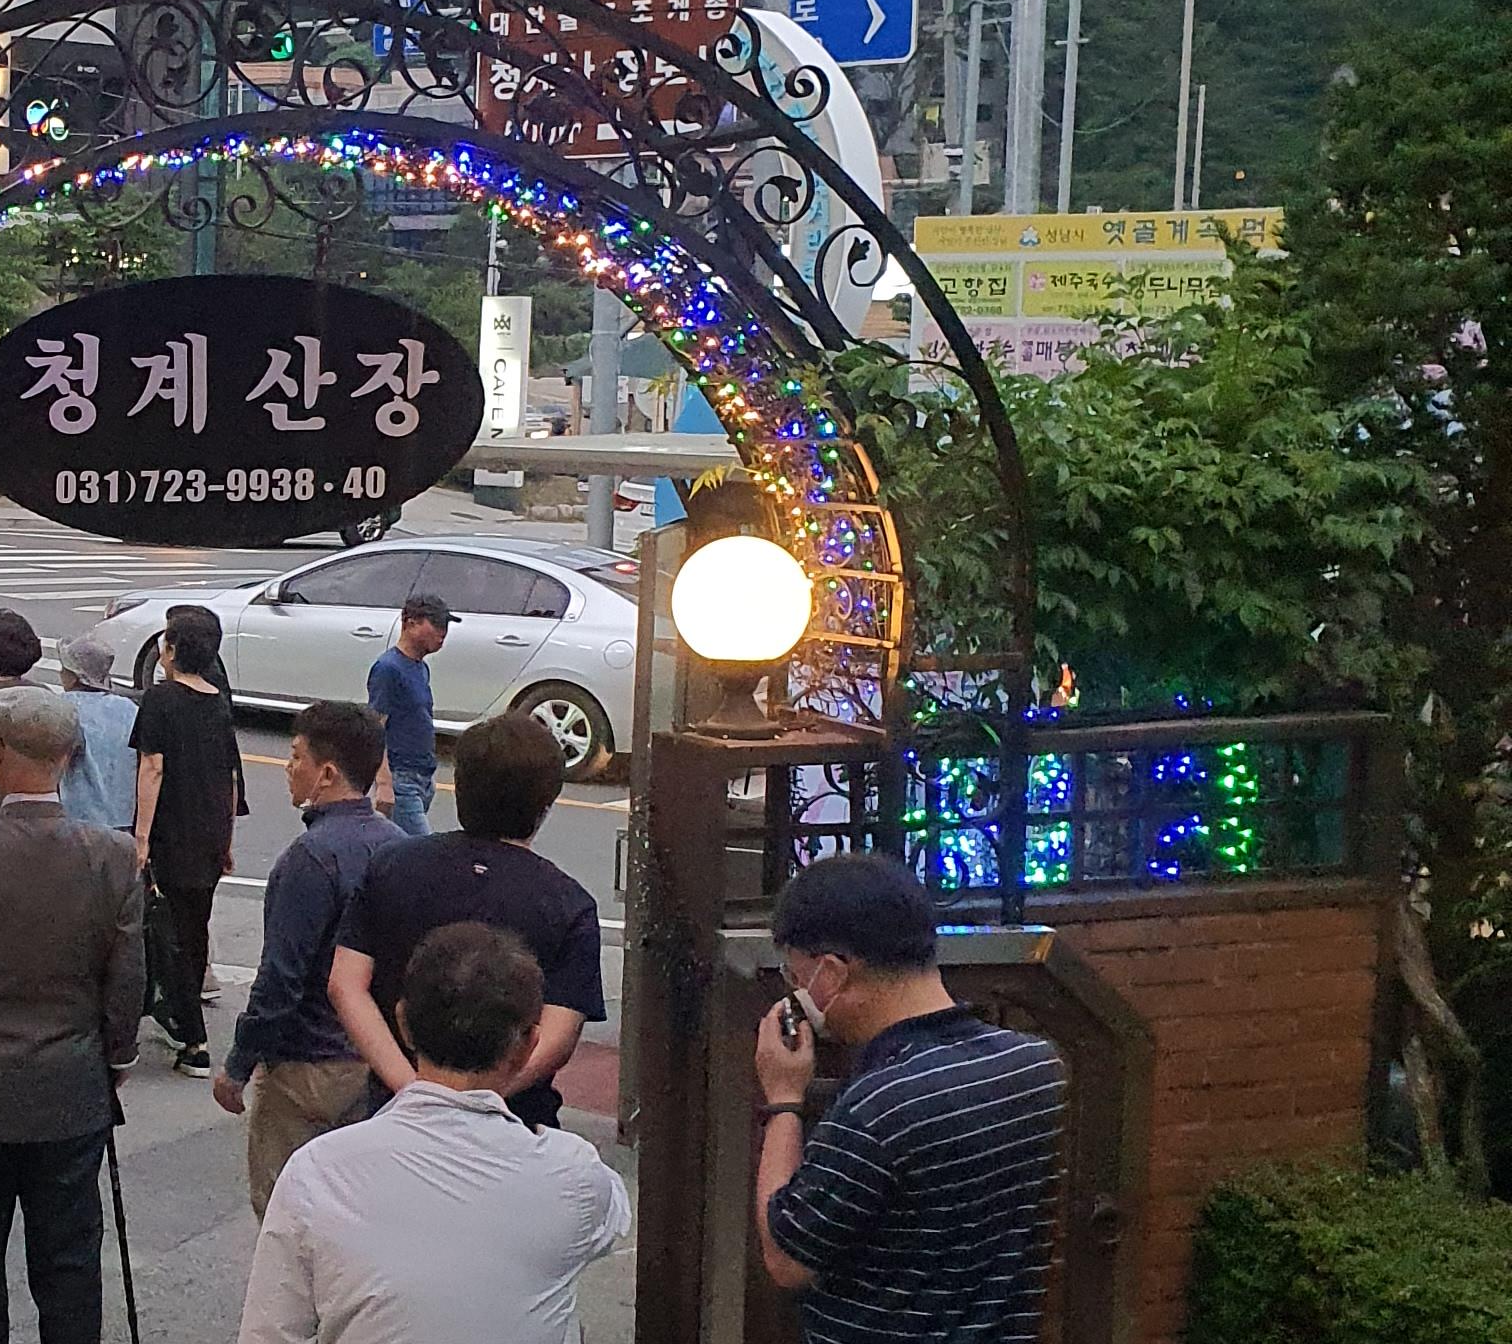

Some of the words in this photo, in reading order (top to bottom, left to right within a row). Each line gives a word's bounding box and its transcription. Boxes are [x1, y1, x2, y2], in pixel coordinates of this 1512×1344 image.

[1045, 227, 1085, 243] 성남시
[939, 276, 1007, 297] 고향집
[19, 331, 441, 437] 청계산장
